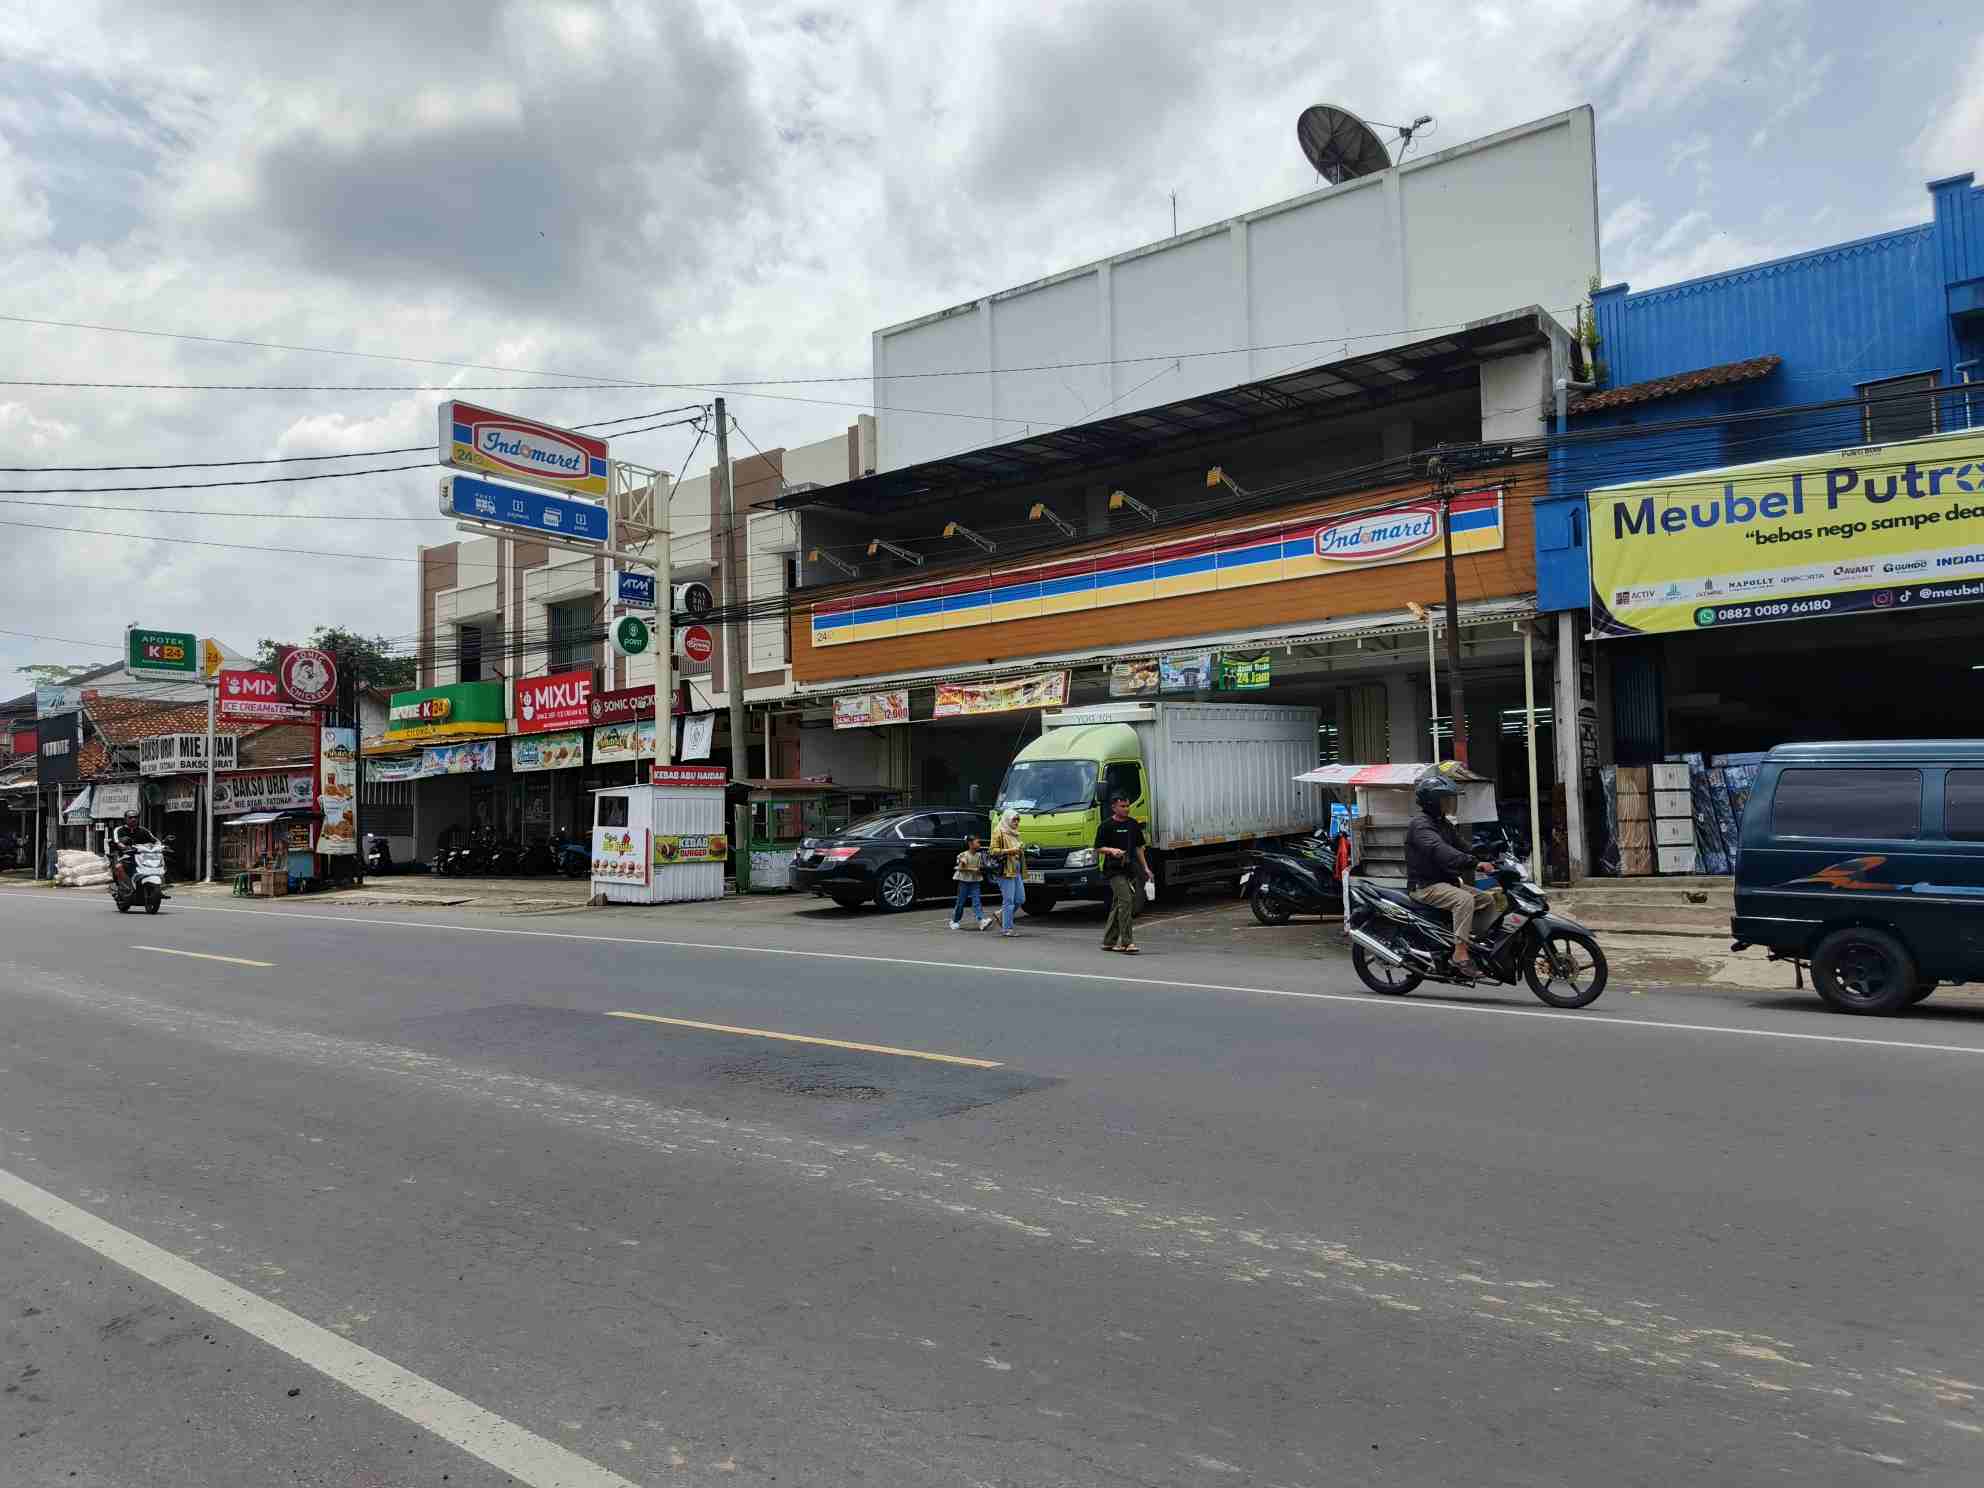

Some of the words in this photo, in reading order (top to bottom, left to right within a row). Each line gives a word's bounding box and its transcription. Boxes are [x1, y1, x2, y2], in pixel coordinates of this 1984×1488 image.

[482, 431, 581, 471] Indomaret
[1613, 473, 1804, 540] Meubel
[1321, 515, 1432, 552] Indomaret
[1817, 520, 1867, 540] nego
[1871, 512, 1940, 530] sampe
[622, 577, 649, 592] ATM
[1718, 607, 1751, 621] 0882
[1754, 603, 1788, 618] 0089
[1791, 599, 1832, 614] 66180
[141, 635, 185, 646] APOTEK
[535, 679, 591, 711] MIXUE
[604, 698, 629, 713] SONIC
[179, 736, 202, 758] MIE
[204, 735, 234, 758] AAM
[232, 775, 264, 798] BAKSO
[265, 774, 289, 795] URAT
